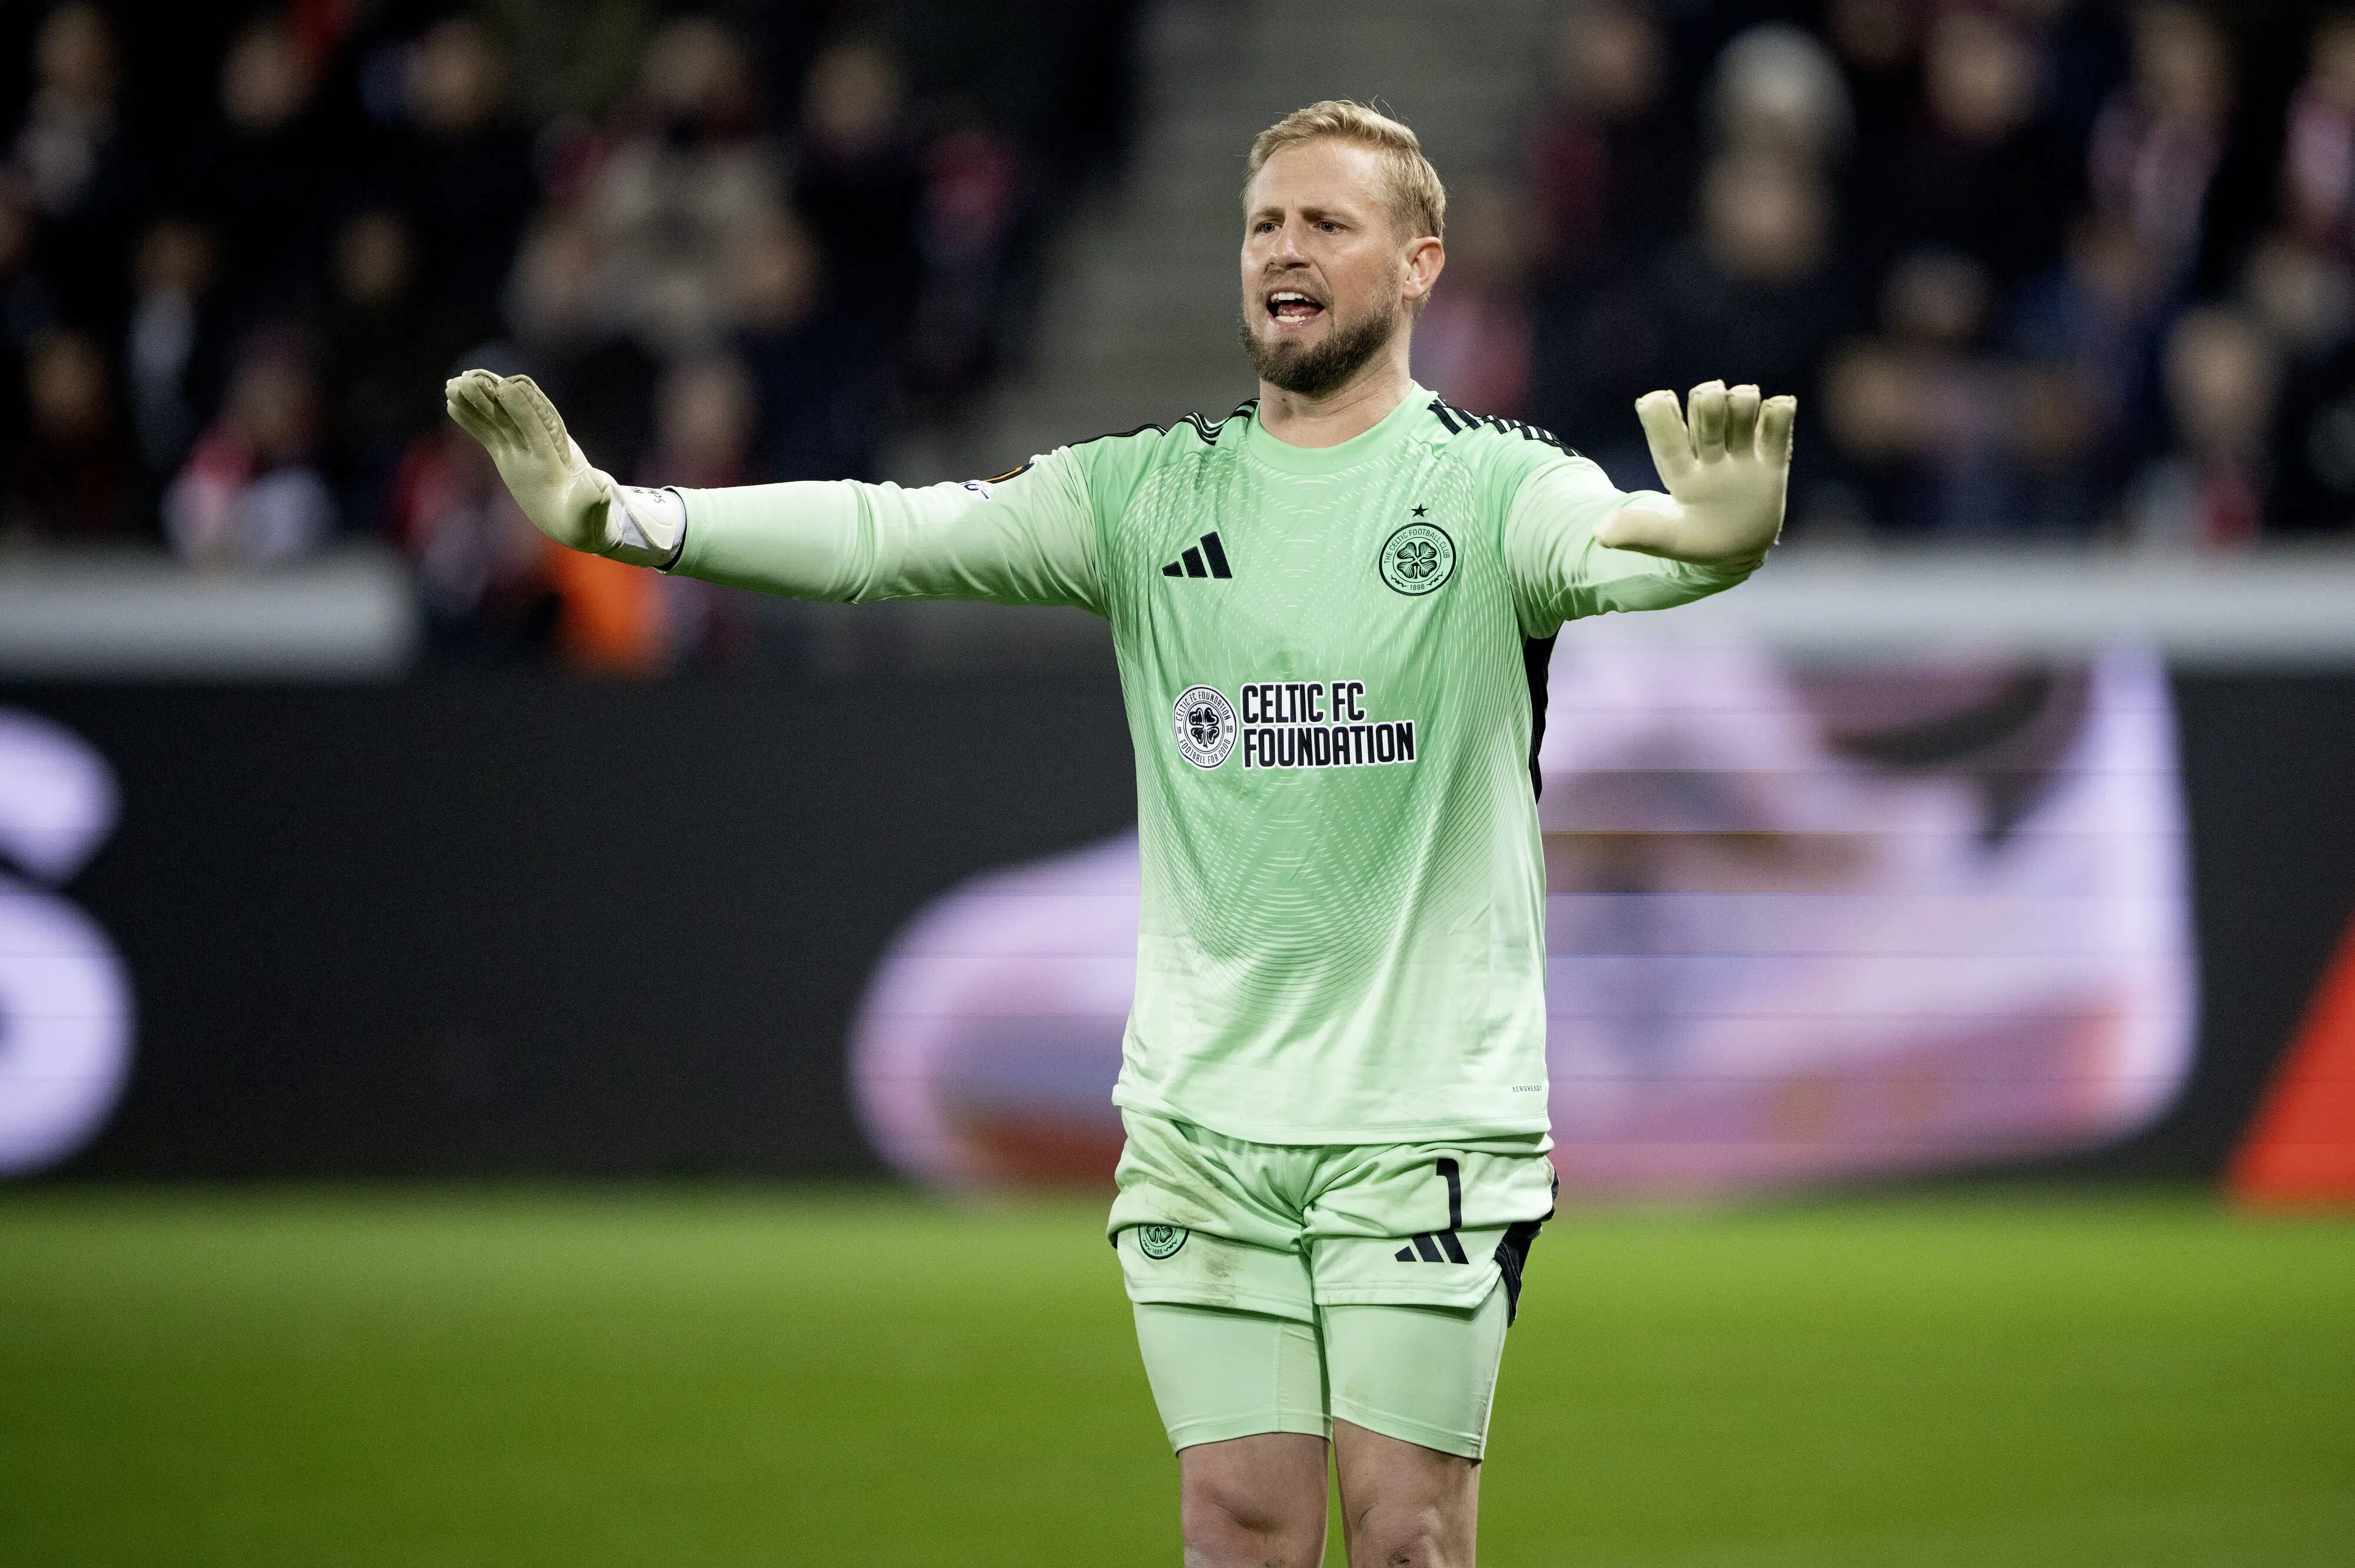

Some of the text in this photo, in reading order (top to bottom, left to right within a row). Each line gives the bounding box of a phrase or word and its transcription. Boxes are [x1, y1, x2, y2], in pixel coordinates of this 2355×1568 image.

[1384, 528, 1450, 564] THE CELTIC FOOTBALL CLUB
[1176, 691, 1231, 721] CELTIC FC FOUNDATION
[1242, 682, 1365, 723] CELTIC FC
[1179, 739, 1230, 764] FOOTBALL FOR GOOD
[1243, 722, 1414, 768] FOUNDATION
[1436, 1158, 1462, 1228] 1
